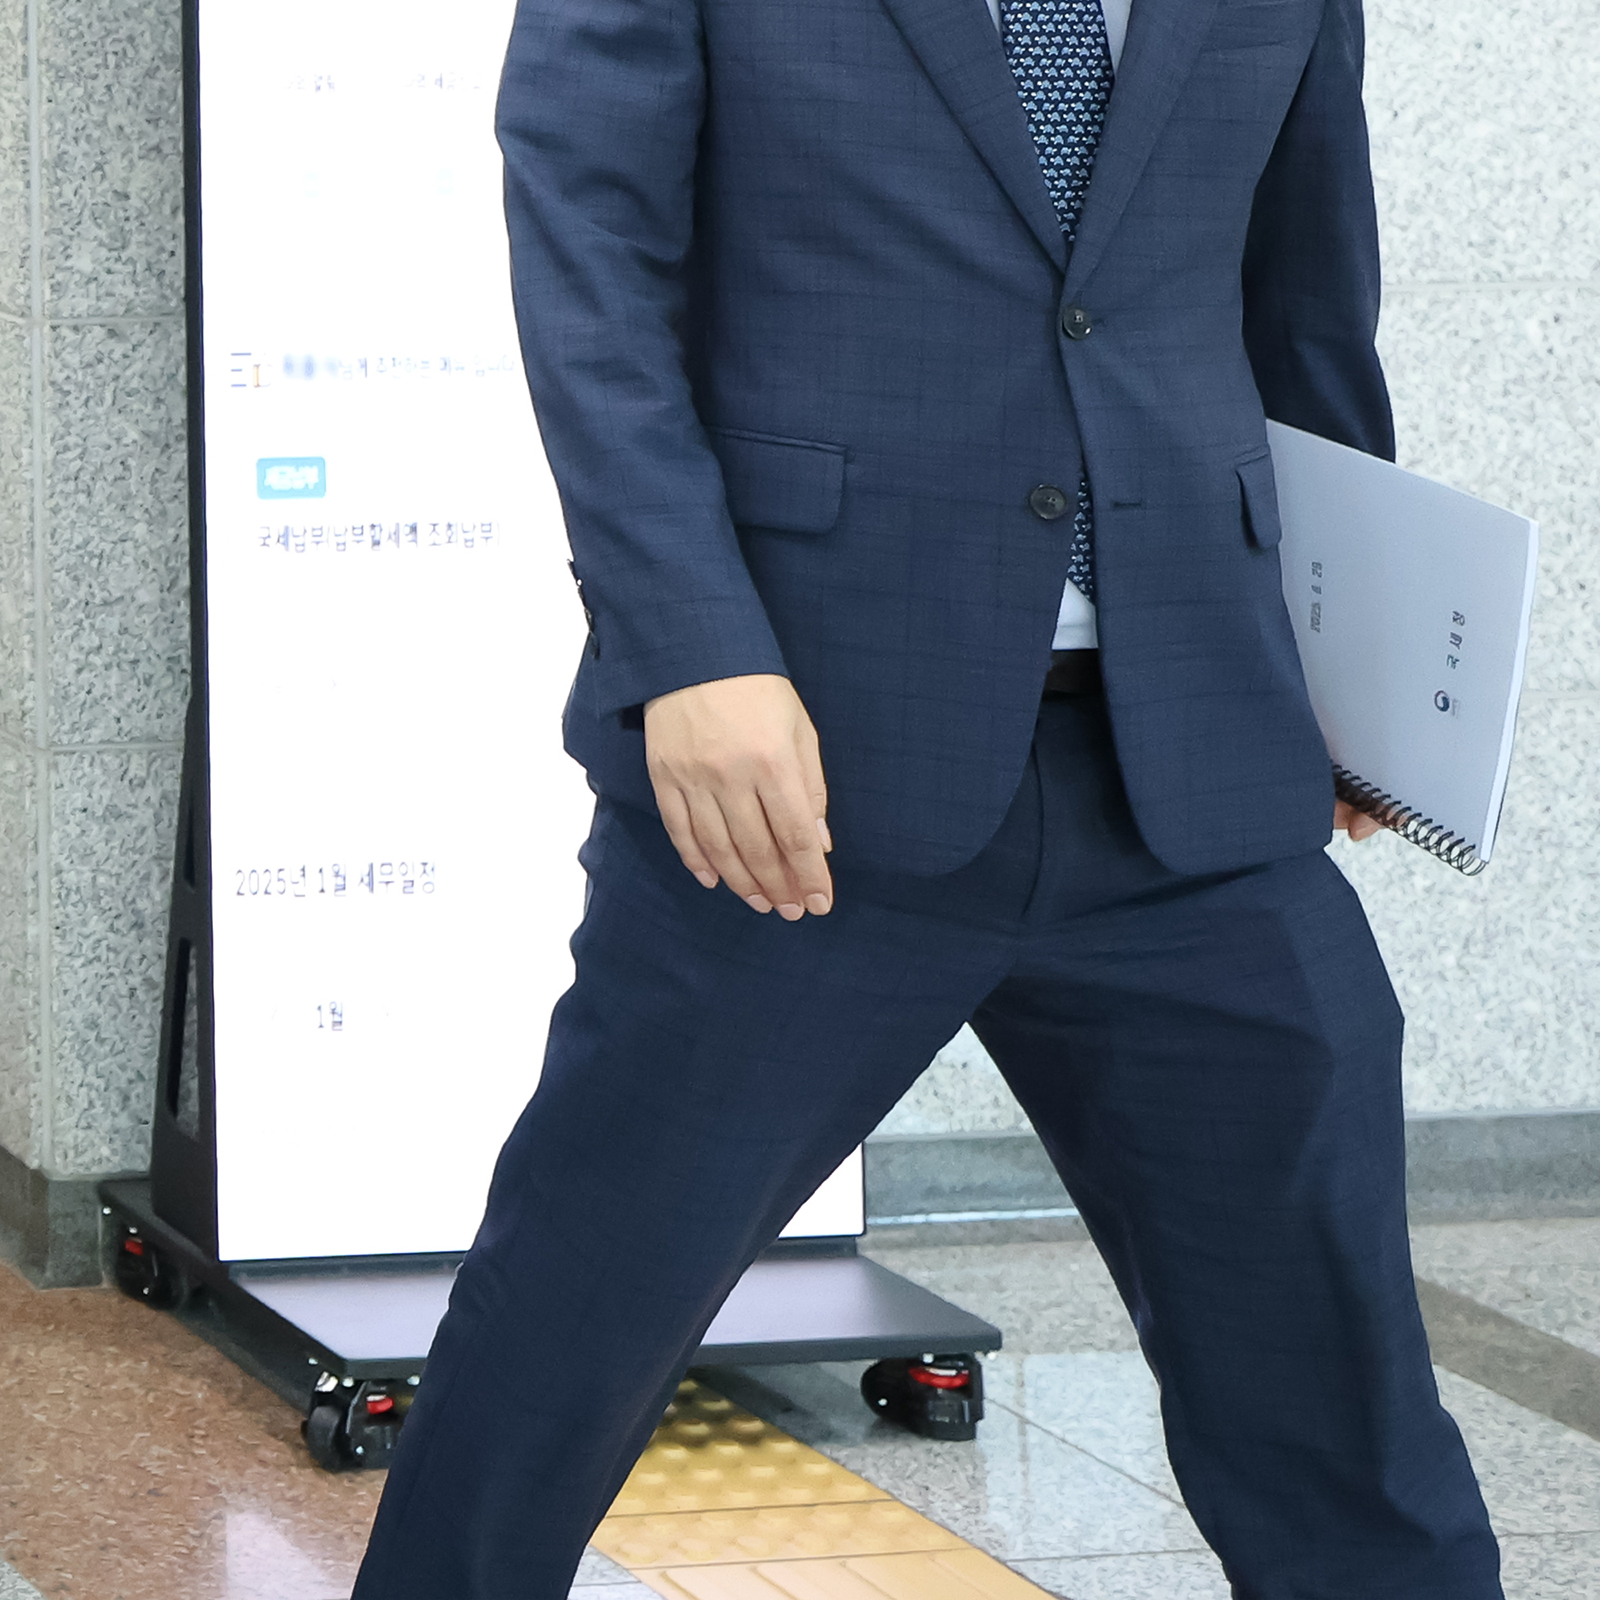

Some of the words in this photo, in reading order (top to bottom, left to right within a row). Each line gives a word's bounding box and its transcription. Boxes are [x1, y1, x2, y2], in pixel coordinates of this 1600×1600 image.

[235, 865, 306, 897] 2025년
[317, 862, 347, 898] 1월
[357, 861, 436, 895] 세무일정
[315, 1000, 344, 1032] 1월
